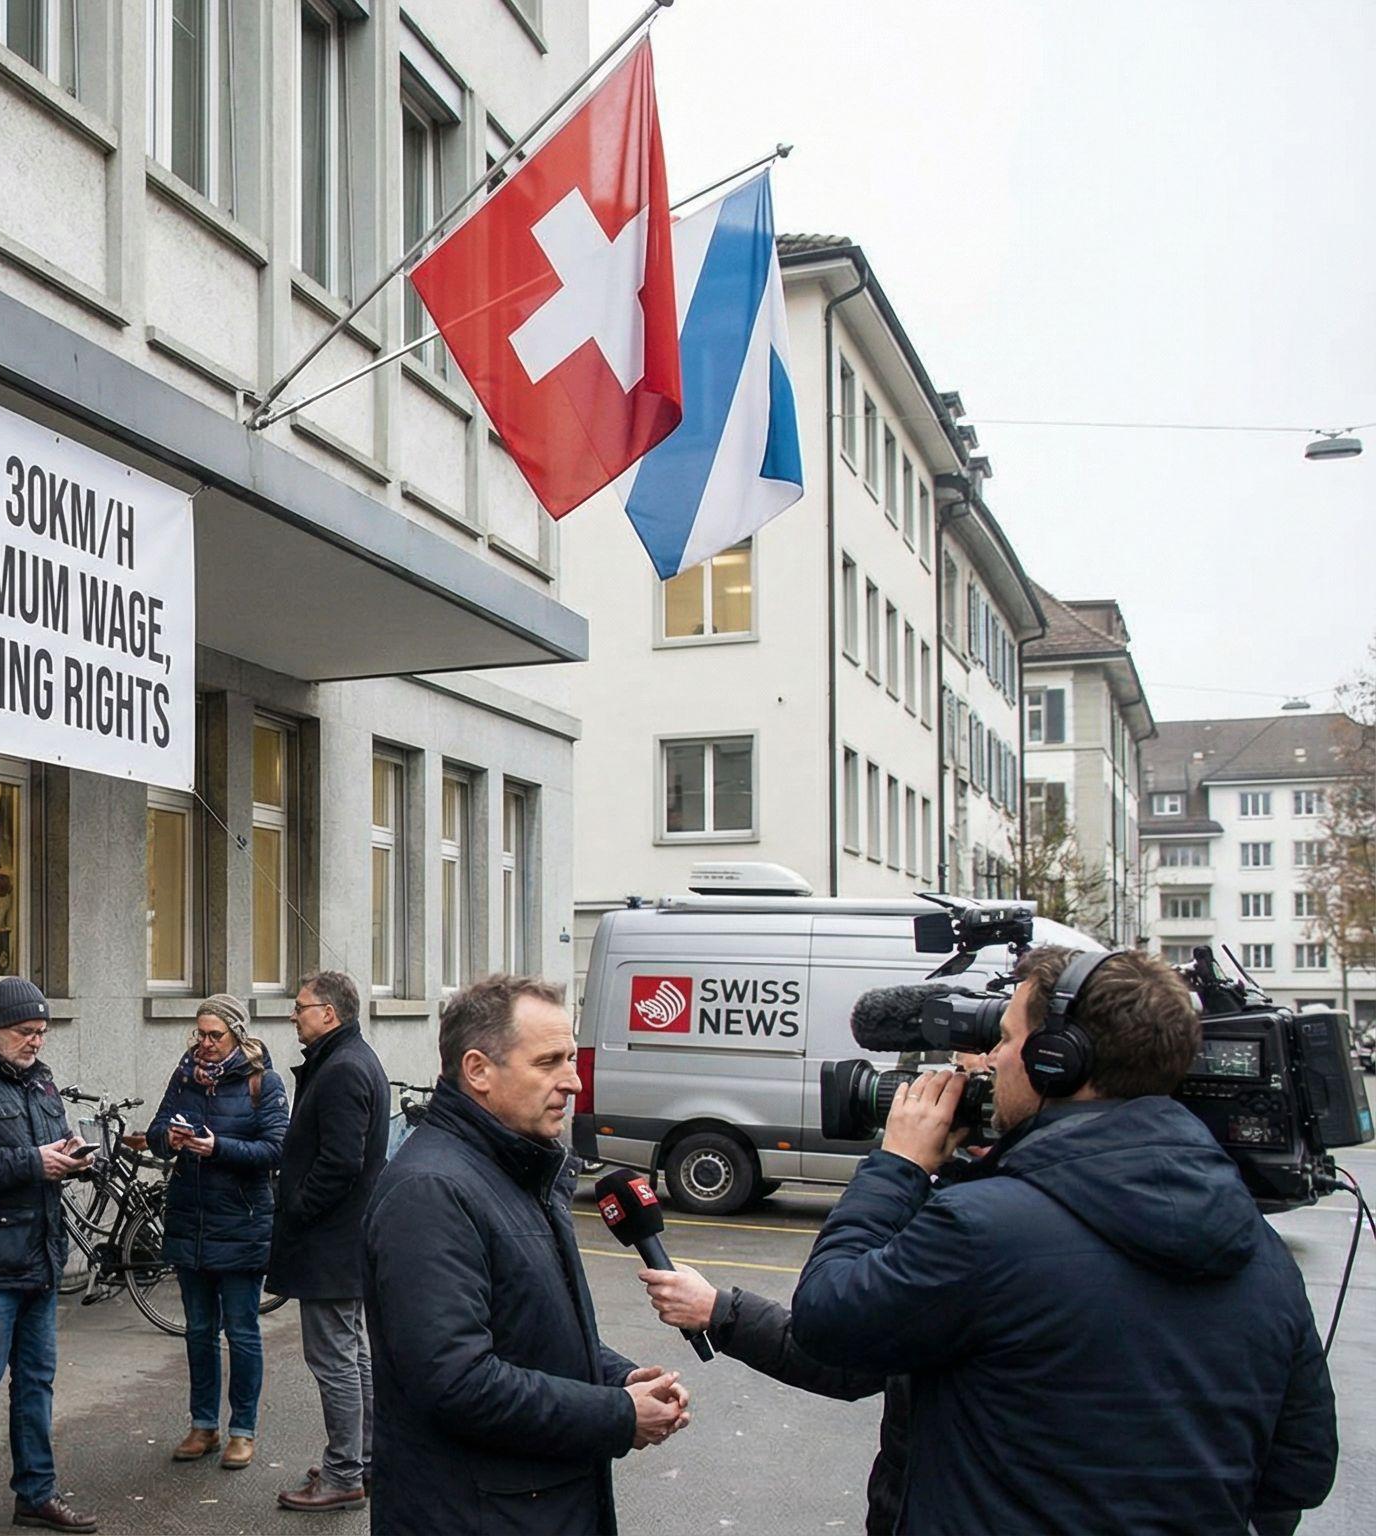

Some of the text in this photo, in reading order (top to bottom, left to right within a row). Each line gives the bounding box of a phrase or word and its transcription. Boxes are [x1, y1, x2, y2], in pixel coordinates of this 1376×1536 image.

[5, 455, 134, 570] 30KM/H
[79, 571, 173, 674] WAGE,
[64, 655, 170, 749] RIGHTS
[698, 1007, 800, 1038] NEWS
[699, 978, 801, 1005] SWISS
